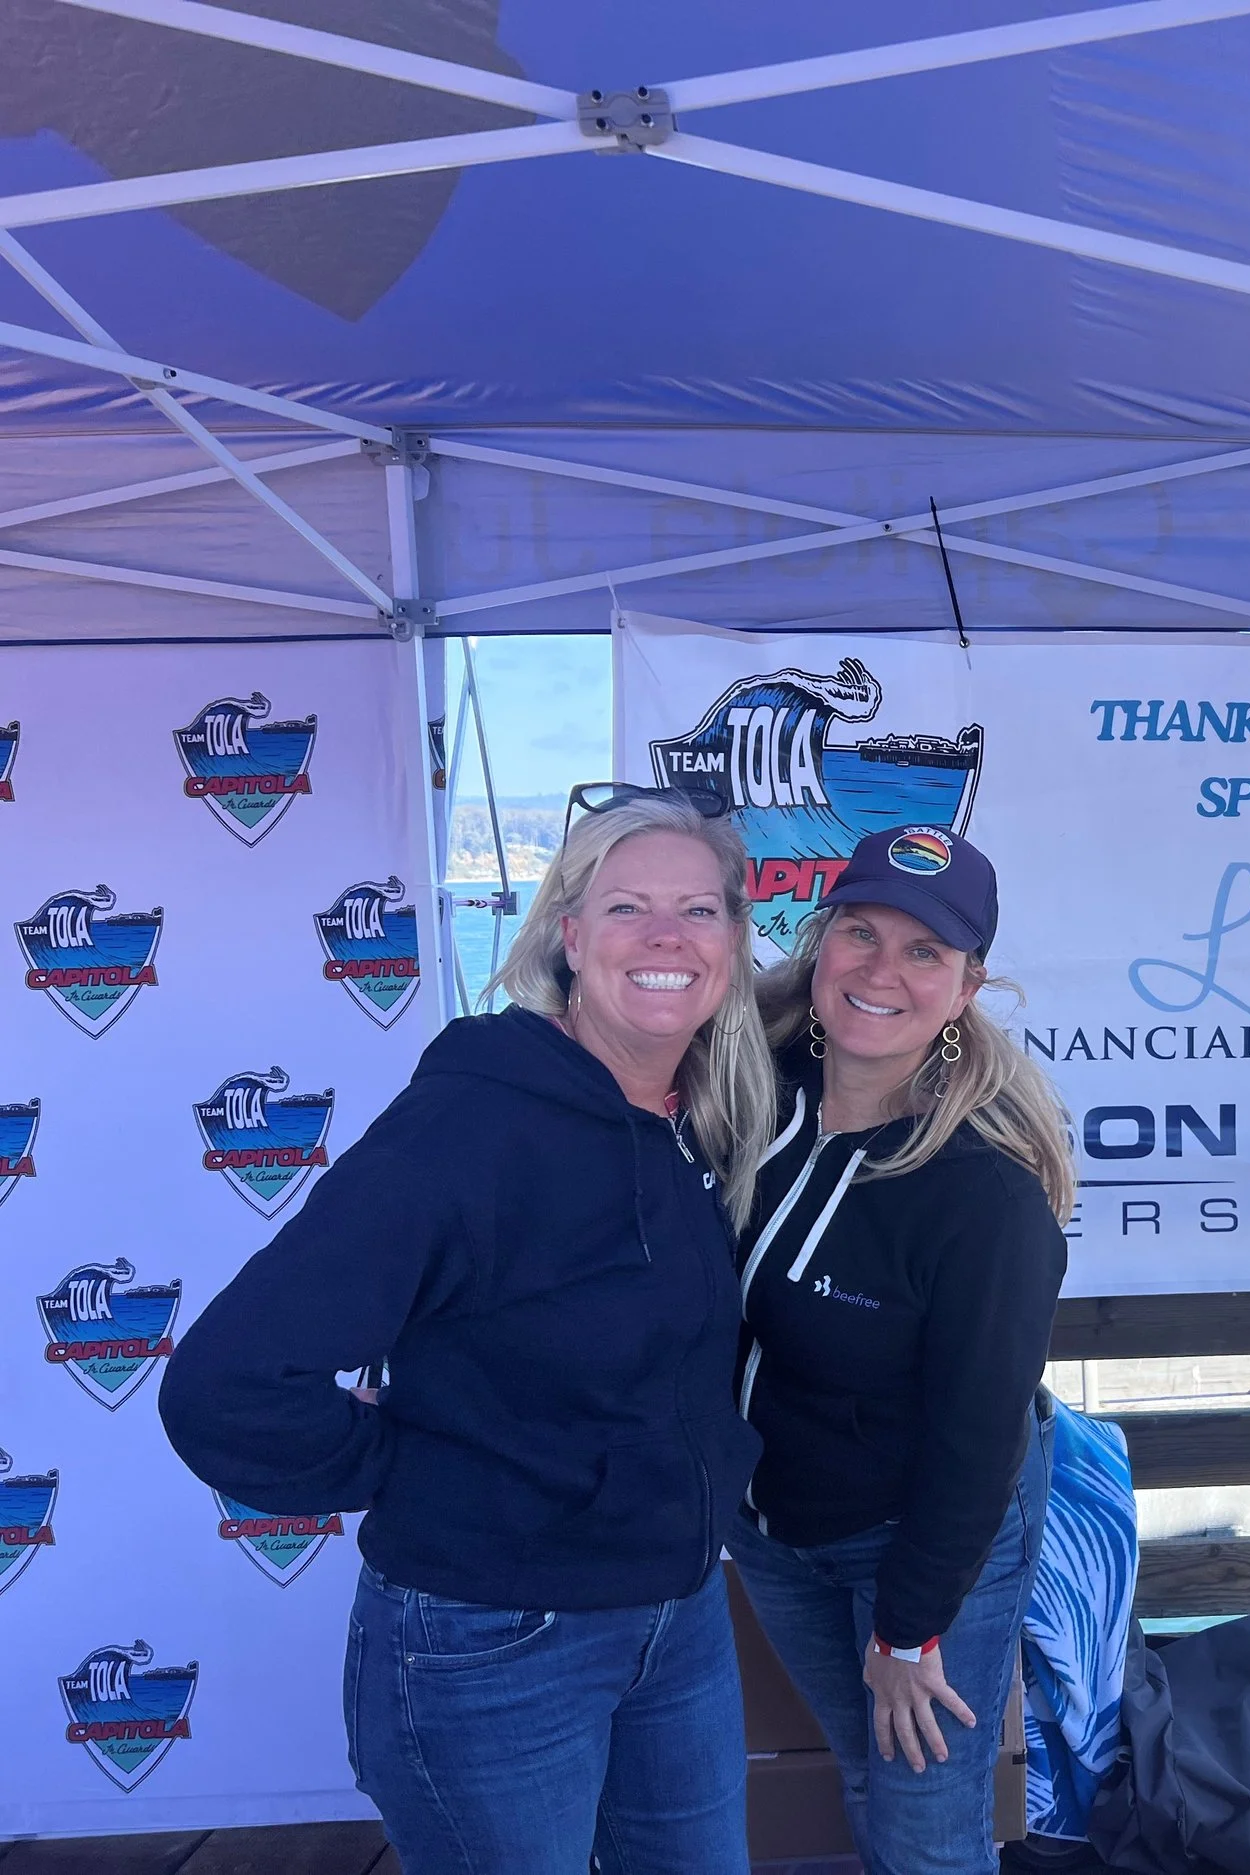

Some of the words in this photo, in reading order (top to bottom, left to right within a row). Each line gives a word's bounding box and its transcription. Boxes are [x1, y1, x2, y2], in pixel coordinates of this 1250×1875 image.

[181, 734, 205, 743] TEAM
[204, 714, 250, 756] TOLA
[669, 751, 725, 773] TEAM
[727, 705, 829, 808] TOLA
[185, 773, 311, 796] CAPITOLA
[907, 827, 952, 846] BATTLE
[23, 926, 48, 935] TEAM
[47, 906, 93, 948] TOLA
[321, 917, 344, 927] TEAM
[343, 897, 386, 940] TOLA
[27, 965, 157, 988] CAPITOLA
[325, 958, 420, 979] CAPITOL
[201, 1107, 224, 1117] TEAM
[224, 1087, 269, 1130] TOLA
[204, 1146, 328, 1169] CAPITOLA
[44, 1299, 68, 1309] TEAM
[68, 1279, 113, 1321] TOLA
[832, 1285, 880, 1309] beefree
[46, 1337, 173, 1362] CAPITOLA
[220, 1515, 343, 1539] CAPITOLA
[66, 1680, 88, 1690] TEAM
[88, 1660, 131, 1702] TOLA
[67, 1718, 190, 1742] CAPITOLA
